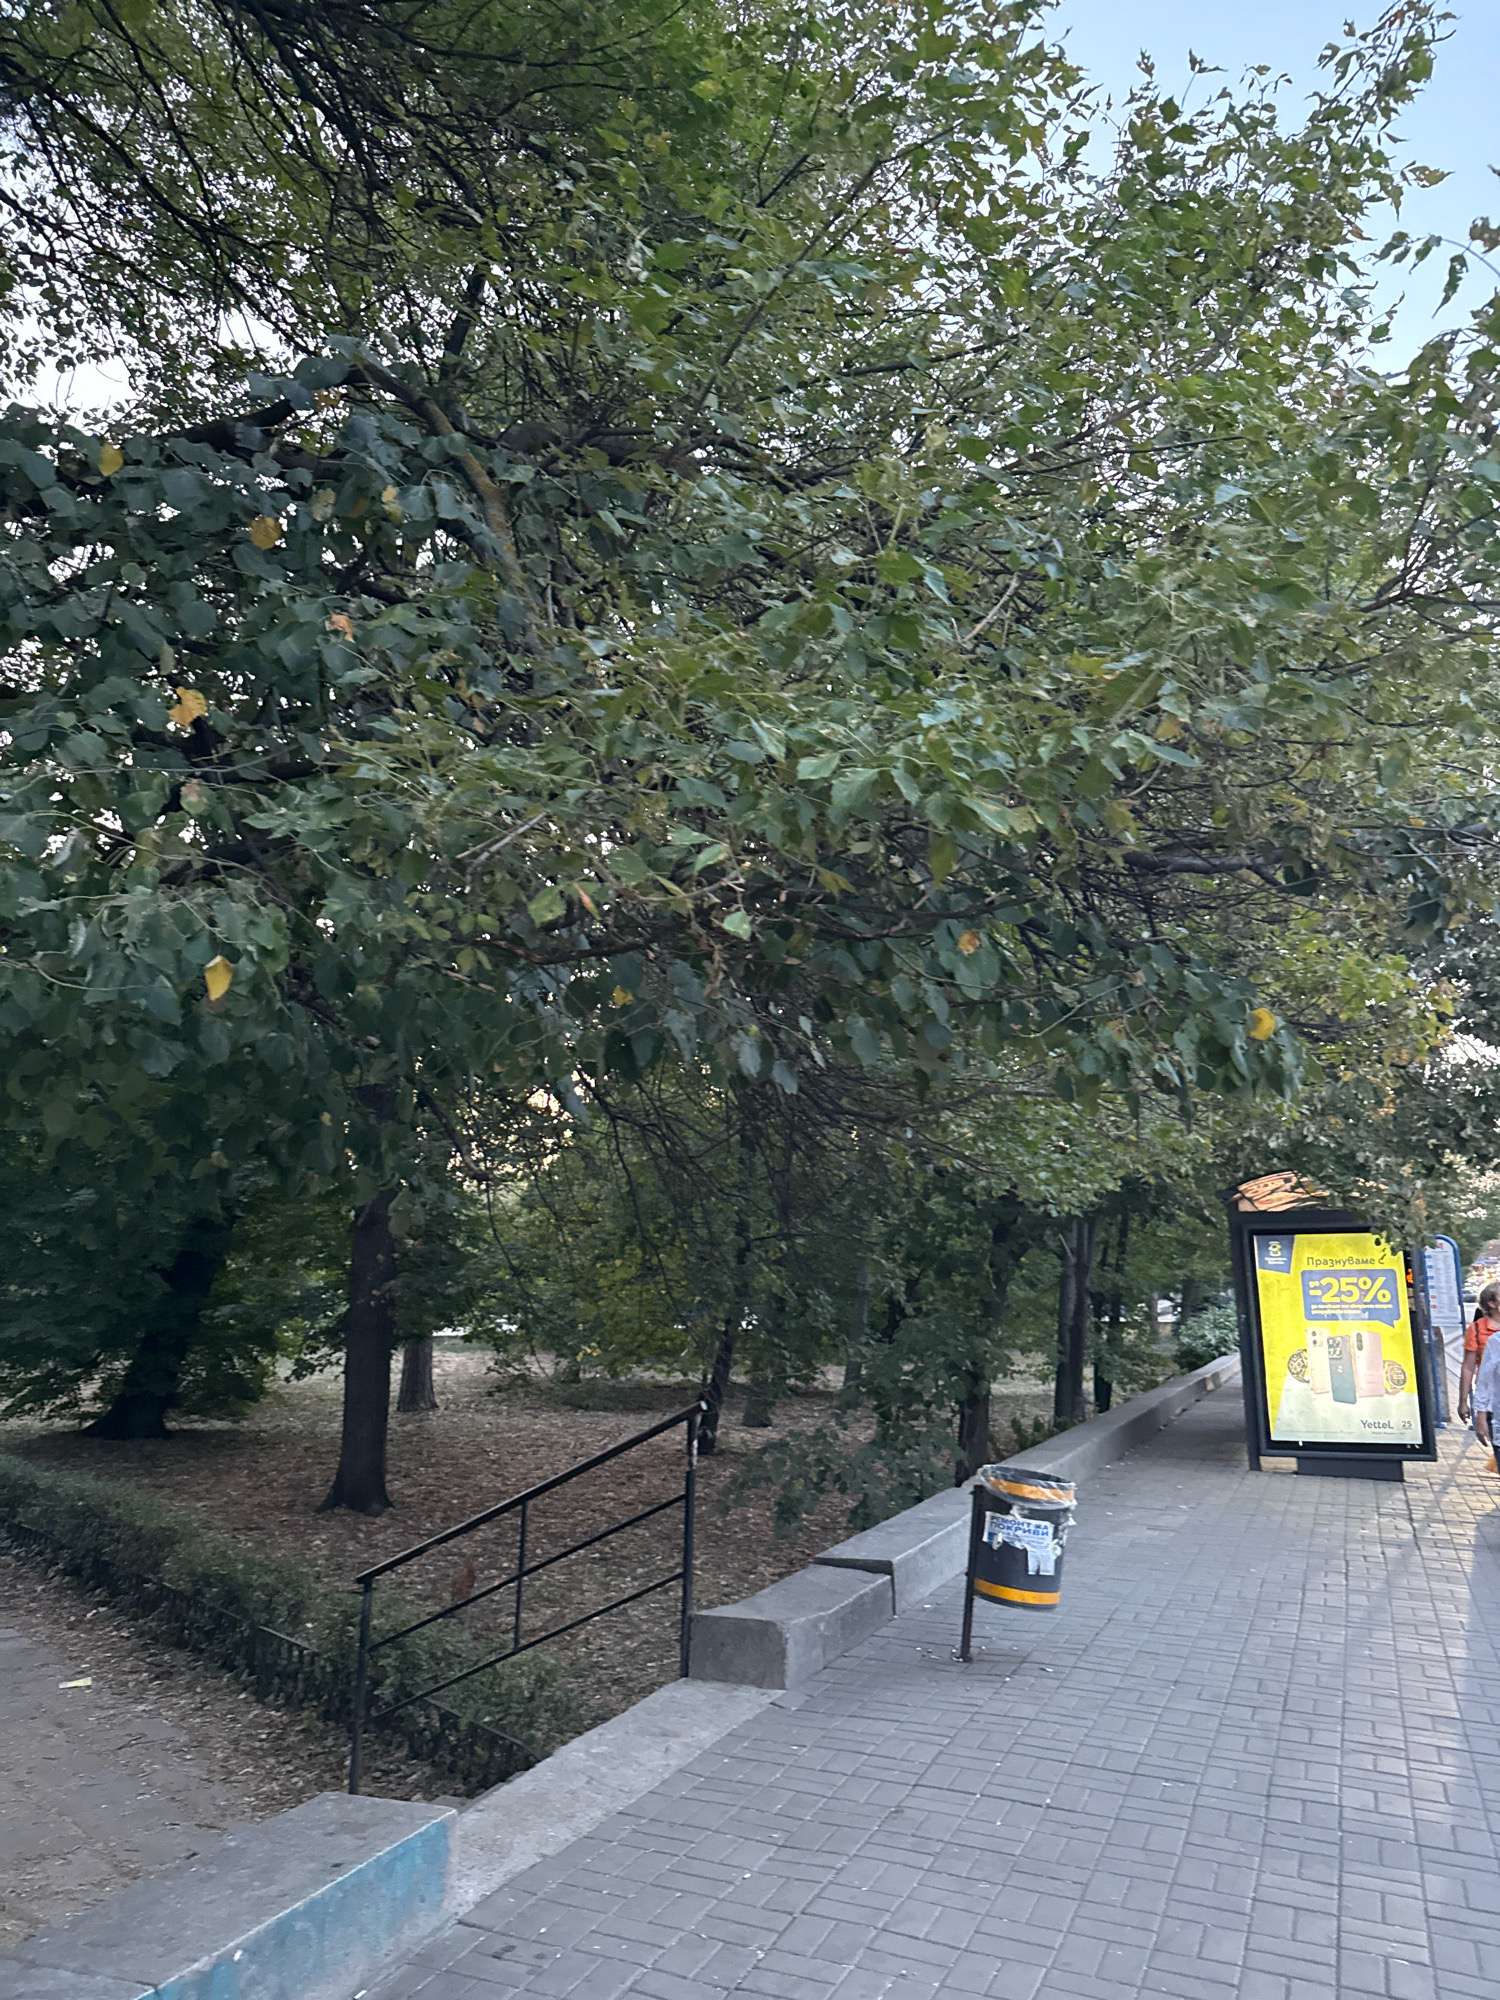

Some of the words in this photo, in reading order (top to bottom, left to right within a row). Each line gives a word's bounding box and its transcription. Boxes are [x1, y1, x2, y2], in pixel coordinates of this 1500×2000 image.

[1306, 1256, 1375, 1267] Празнуваме
[1309, 1276, 1391, 1303] -25%
[991, 1521, 1049, 1537] ПОКРИВИ
